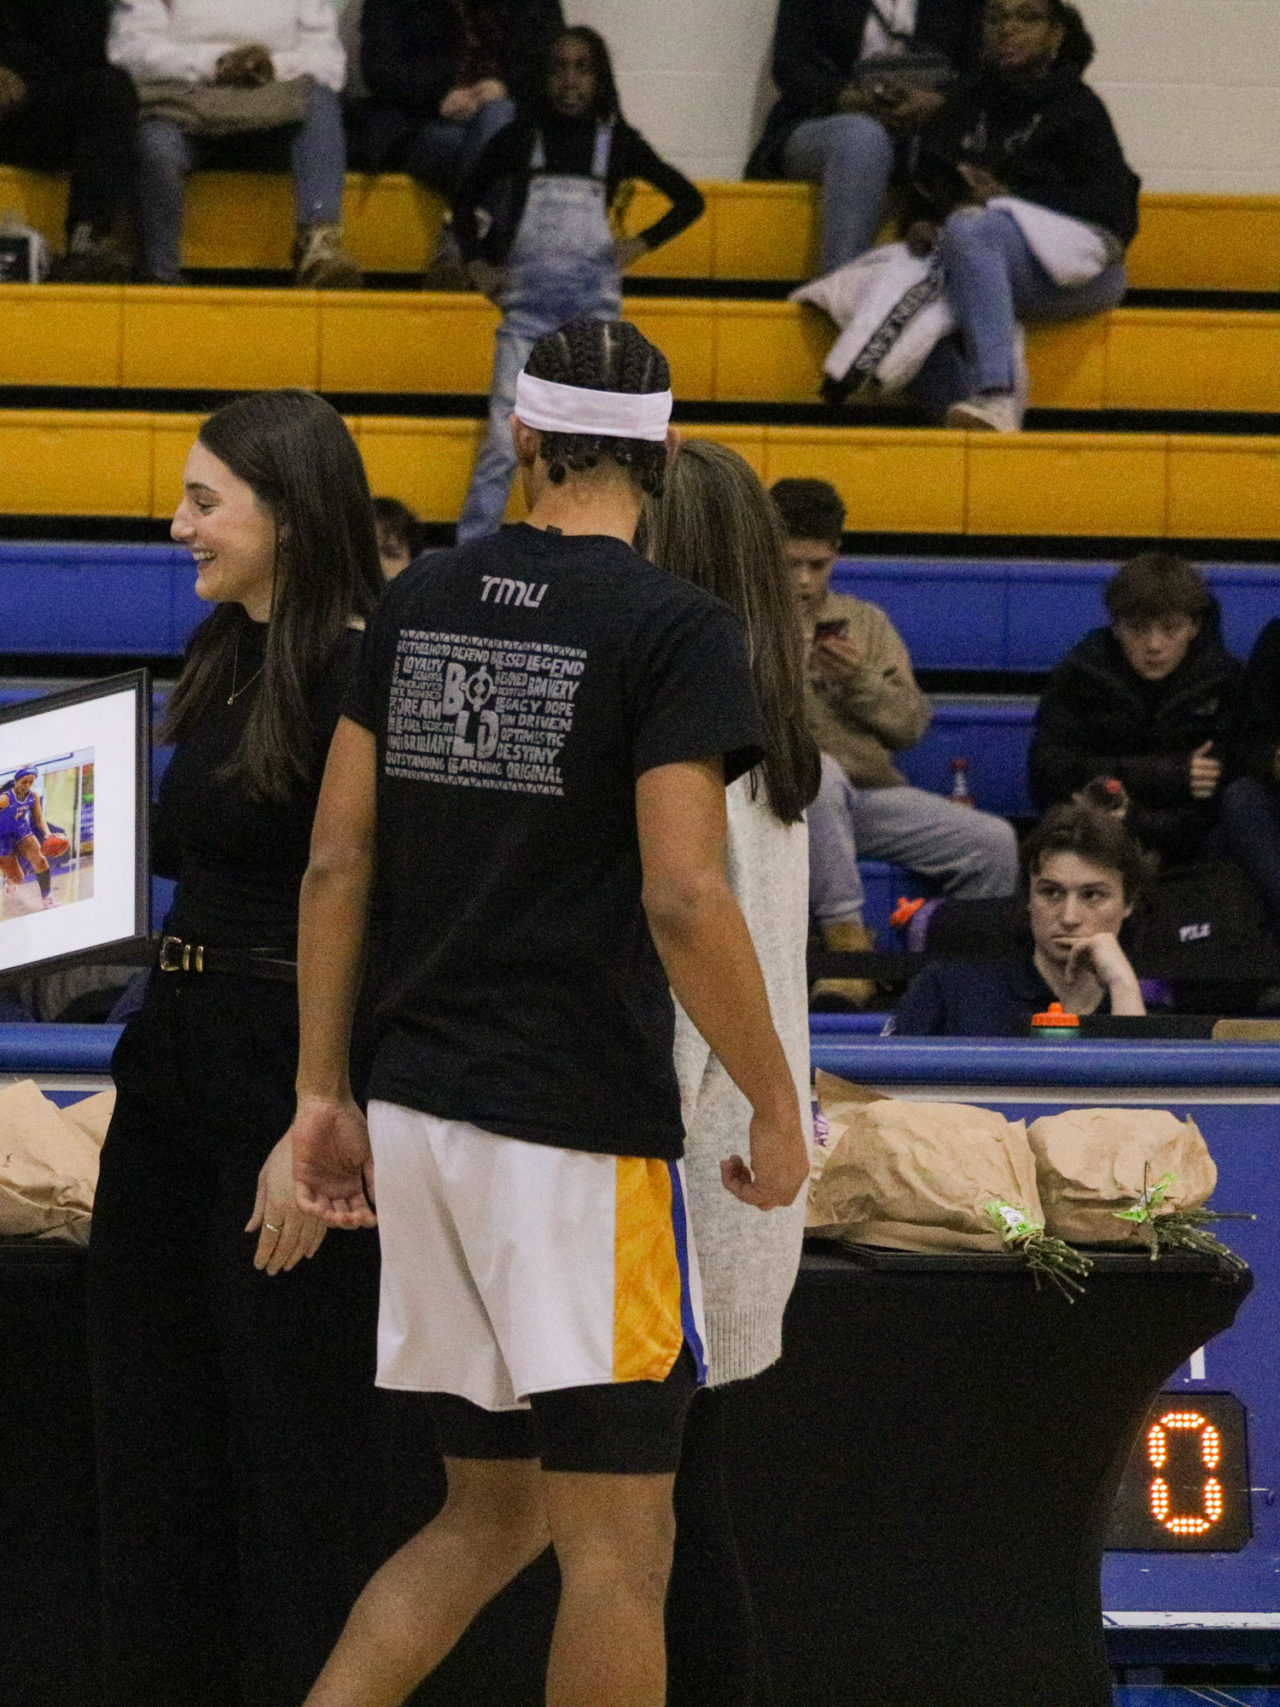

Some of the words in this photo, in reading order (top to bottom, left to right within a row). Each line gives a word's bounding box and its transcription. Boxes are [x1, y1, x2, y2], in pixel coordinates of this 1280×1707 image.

[481, 575, 548, 608] TMU
[402, 656, 445, 674] LOYALTY
[451, 646, 490, 663] DEFEND
[525, 654, 585, 678] LEGEND
[526, 676, 580, 701] BRAVERY
[397, 698, 442, 720] DREAM
[495, 696, 542, 713] LEGACY
[544, 700, 575, 717] DOPE
[518, 713, 573, 732] DRIVEN
[403, 732, 454, 756] BRILLIANT
[501, 727, 566, 747] OPTIMISTIC
[496, 742, 560, 764] DESTINY
[385, 751, 445, 771] OUTSTANDING
[447, 757, 503, 776] LEARNING
[506, 761, 564, 784] ORIGINAL
[1147, 1411, 1222, 1535] 0
